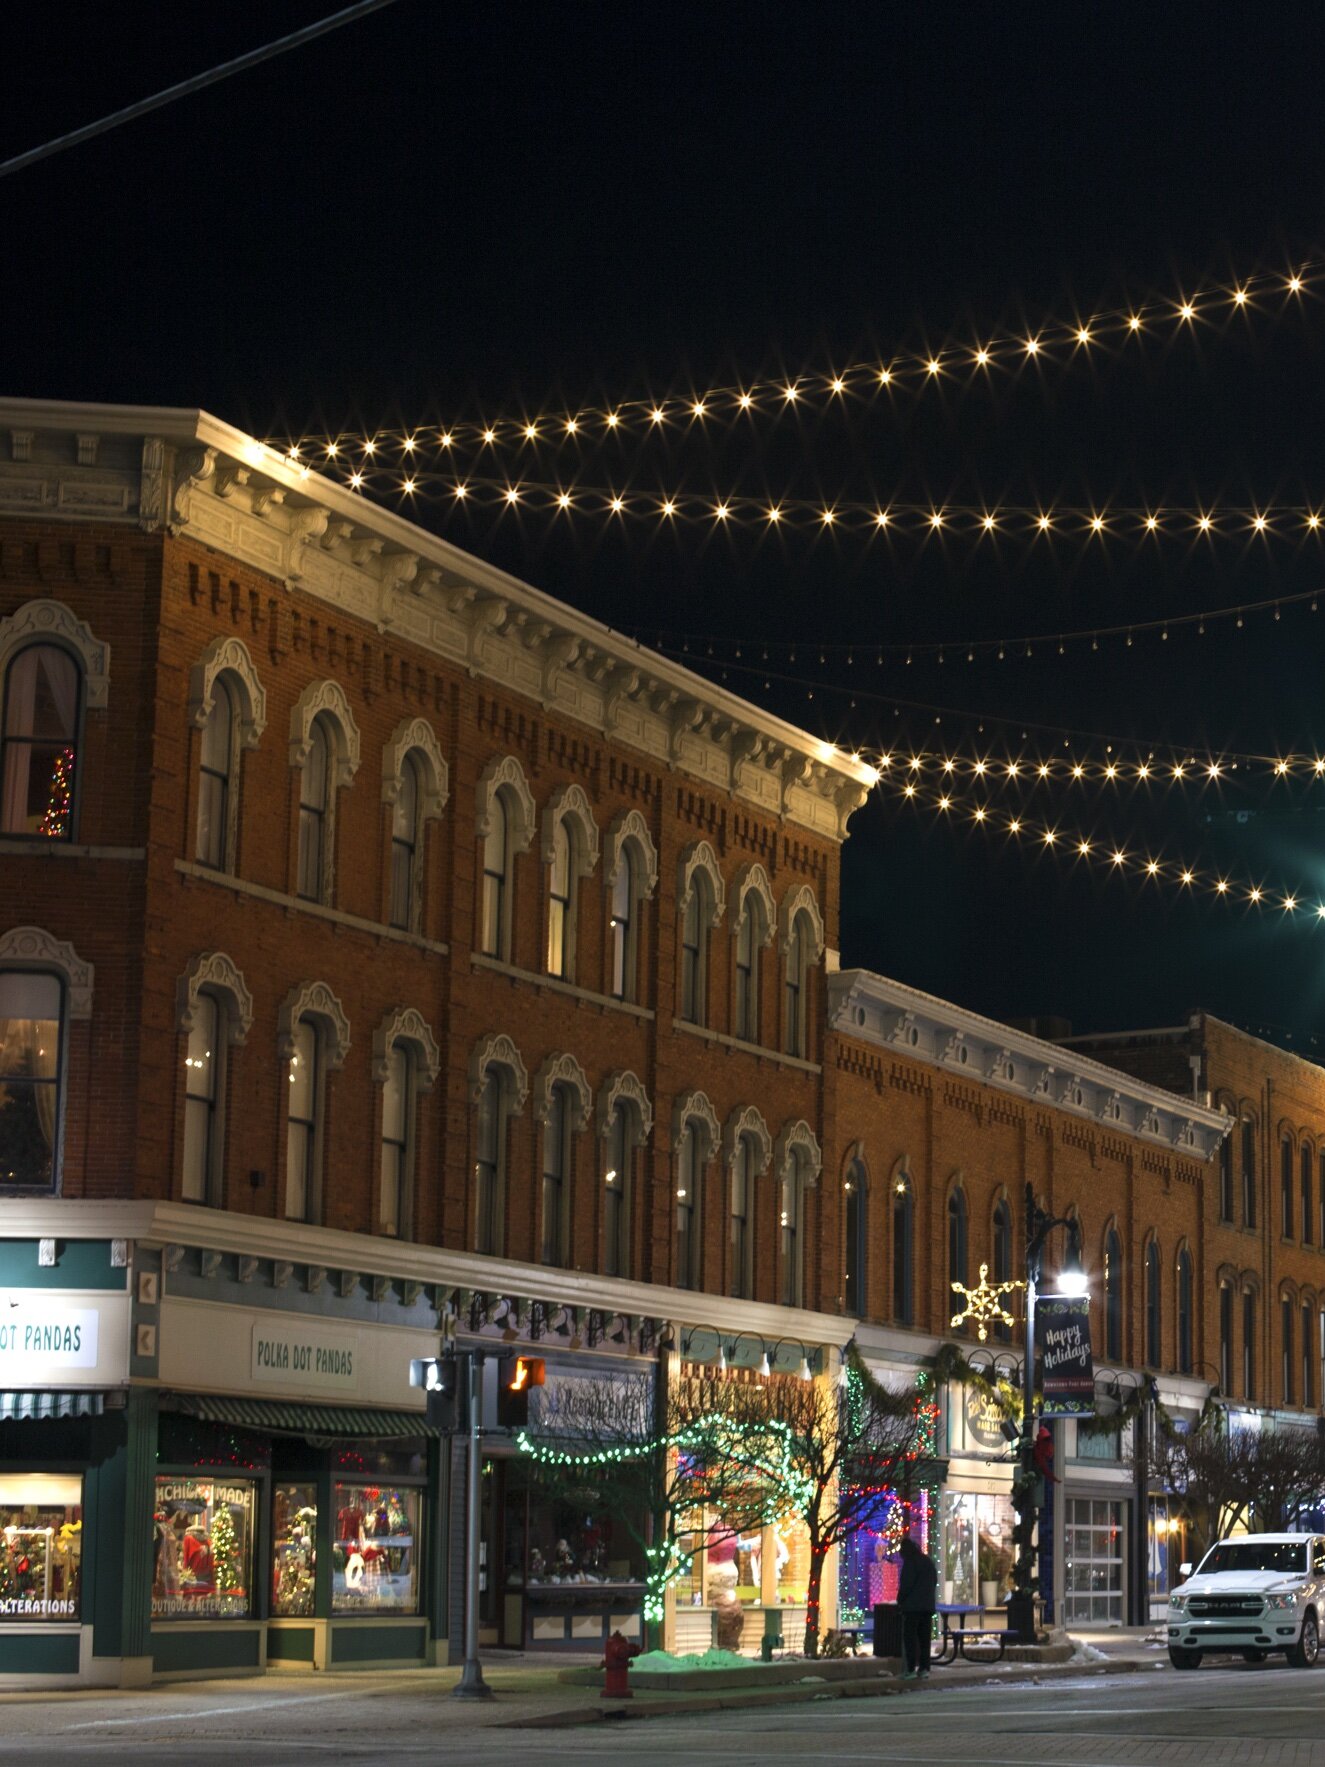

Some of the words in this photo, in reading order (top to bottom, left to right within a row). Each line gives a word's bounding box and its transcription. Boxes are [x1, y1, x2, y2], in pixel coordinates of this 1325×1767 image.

[25, 1325, 81, 1351] PANDAS
[1046, 1325, 1082, 1346] Happy
[257, 1340, 288, 1369] POLKA
[293, 1344, 312, 1371] DOT
[315, 1347, 352, 1376] PANDAS
[1044, 1343, 1091, 1369] Holidays
[216, 1486, 251, 1508] MADE
